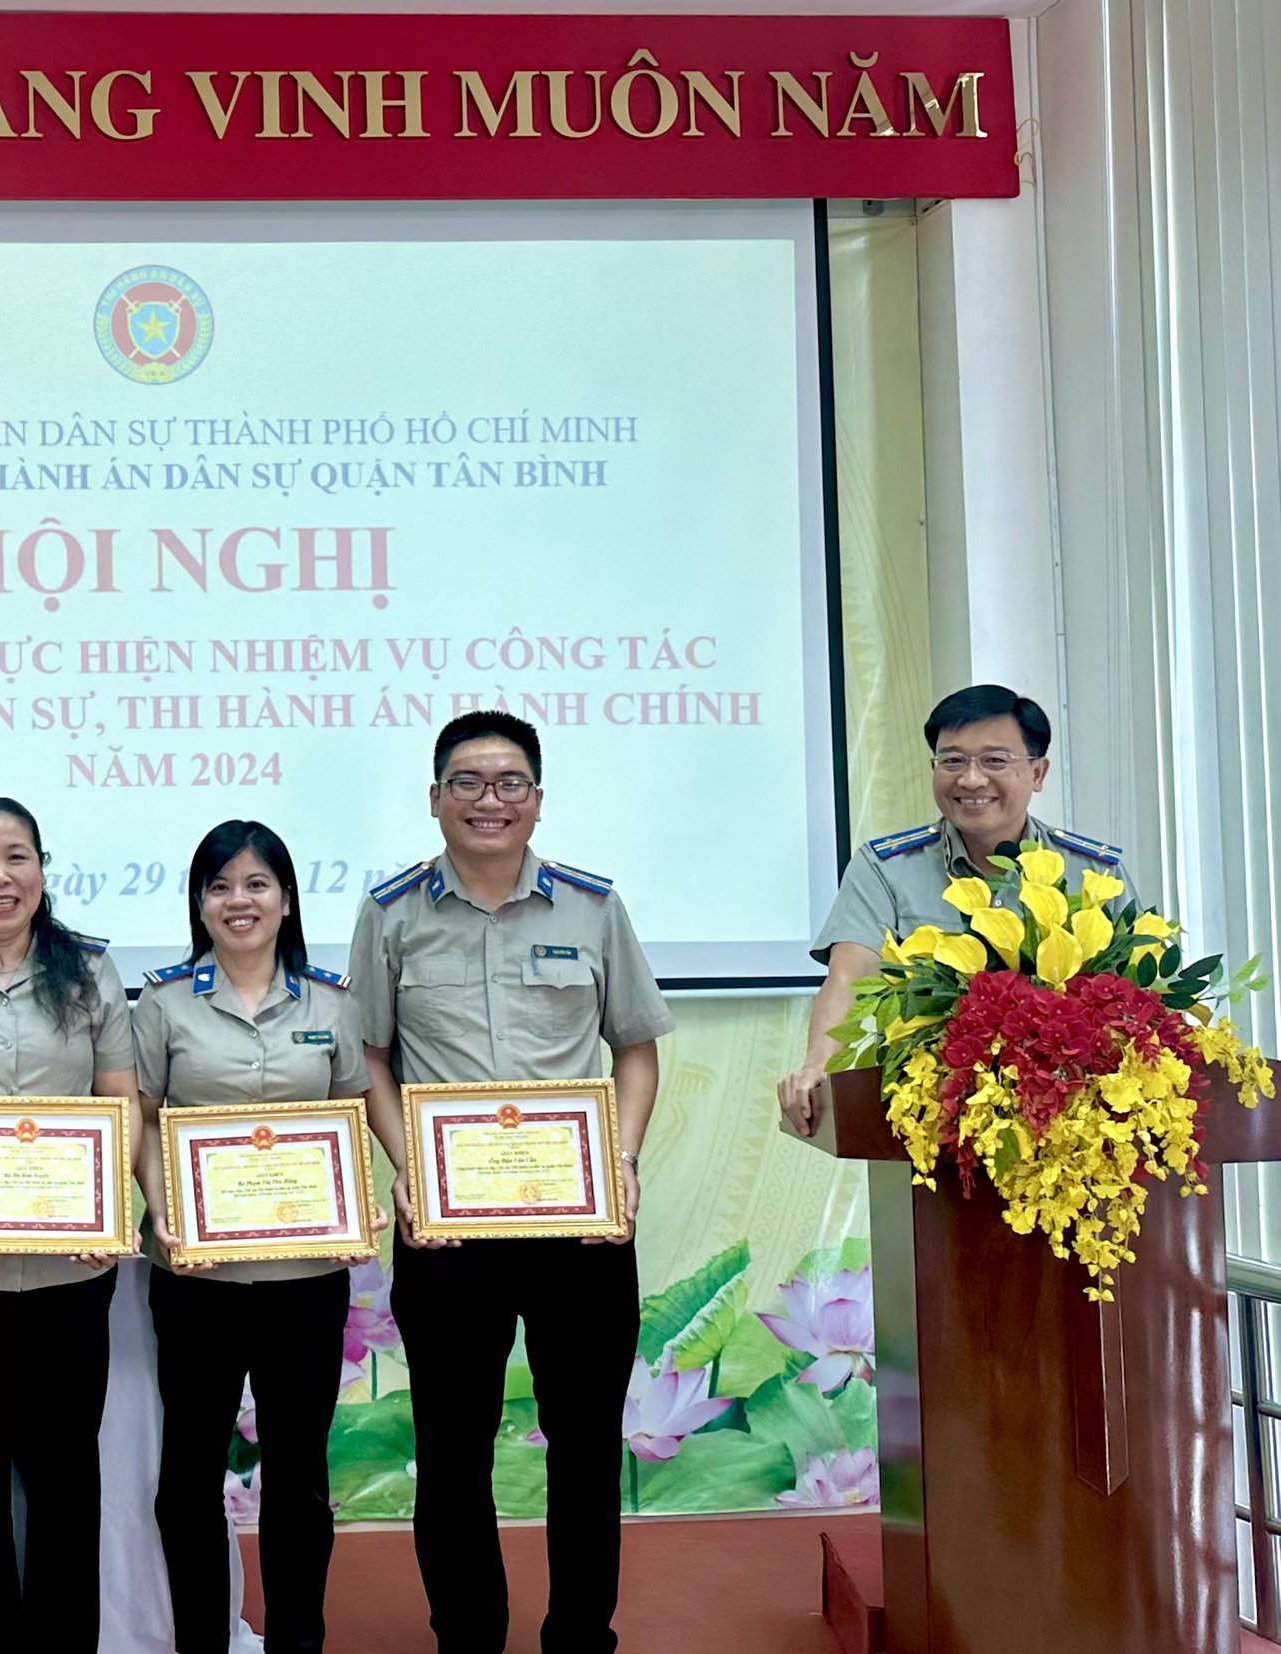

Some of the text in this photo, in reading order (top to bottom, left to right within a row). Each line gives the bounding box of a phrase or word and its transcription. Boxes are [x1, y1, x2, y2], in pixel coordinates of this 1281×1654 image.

[185, 72, 431, 140] VINH
[453, 49, 745, 139] MUÔN
[770, 52, 988, 139] NĂM
[38, 411, 118, 447] DÂN
[128, 416, 178, 452] SỰ
[184, 410, 312, 446] THÀNH
[322, 411, 395, 446] PHỐ
[404, 410, 457, 445] HỒ
[467, 408, 530, 444] CHÍ
[539, 416, 638, 444] MINH
[101, 456, 154, 490] ÁN
[162, 454, 242, 491] DÂN
[251, 458, 303, 498] SỰ
[310, 458, 417, 497] QUẬN
[426, 452, 504, 488] TÂN
[514, 454, 608, 488] BÌNH
[147, 524, 397, 612] NGHỊ
[77, 636, 193, 682] HIỆN
[208, 634, 377, 681] NHIỆM
[385, 637, 451, 681] VỤ
[465, 627, 605, 671] CÔNG
[618, 636, 717, 670] TÁC
[31, 690, 106, 740] SỰ,
[117, 698, 202, 730] THI
[219, 687, 355, 728] HÀNH
[369, 685, 435, 728] ÁN
[602, 684, 762, 726] CHÍNH
[65, 745, 284, 788] NĂM 2024
[45, 862, 107, 906] gày
[119, 861, 166, 896] 29
[302, 859, 349, 894] 12
